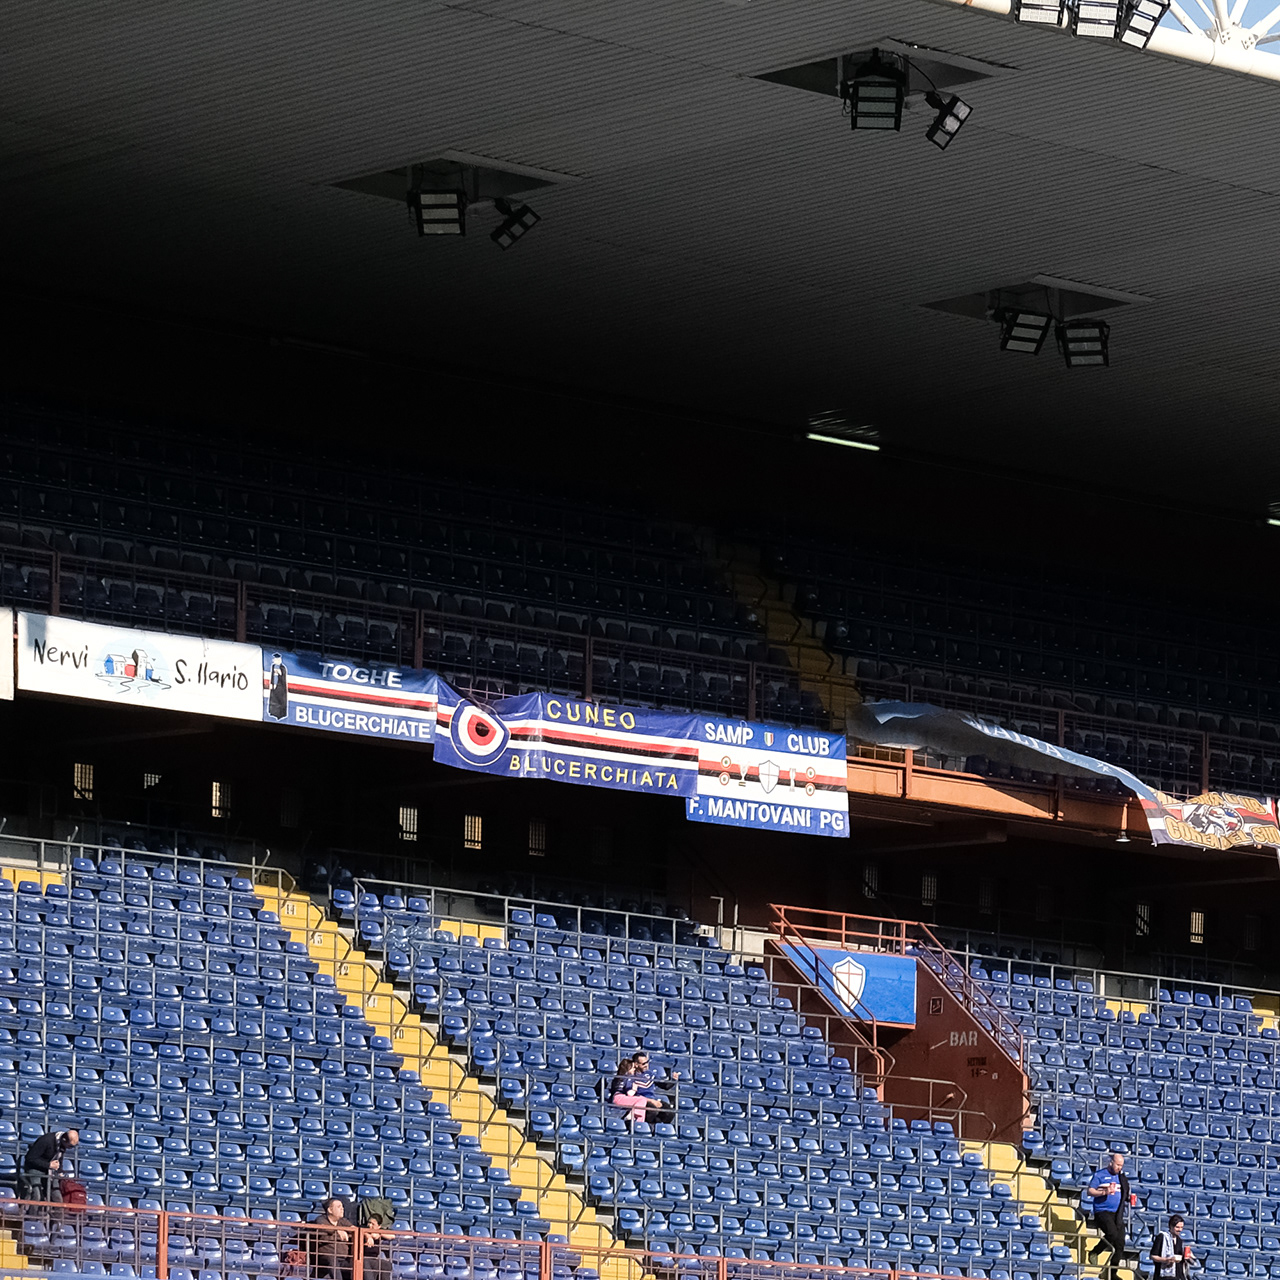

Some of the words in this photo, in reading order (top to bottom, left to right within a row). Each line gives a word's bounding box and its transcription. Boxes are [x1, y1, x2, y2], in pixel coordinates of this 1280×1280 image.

[33, 638, 89, 669] Nervi
[174, 658, 192, 685] S.
[196, 661, 250, 691] Ilario
[318, 661, 403, 689] TOGHE
[295, 705, 431, 739] BLUCERCHIATE
[546, 699, 636, 730] CUNEO
[705, 721, 754, 746] SAMP
[787, 733, 830, 756] CLUB
[509, 754, 679, 790] BLUCERCHIATA
[688, 797, 704, 816] F.
[707, 797, 812, 829] MANTOVANI
[819, 808, 845, 831] PG
[950, 1030, 978, 1047] BAR
